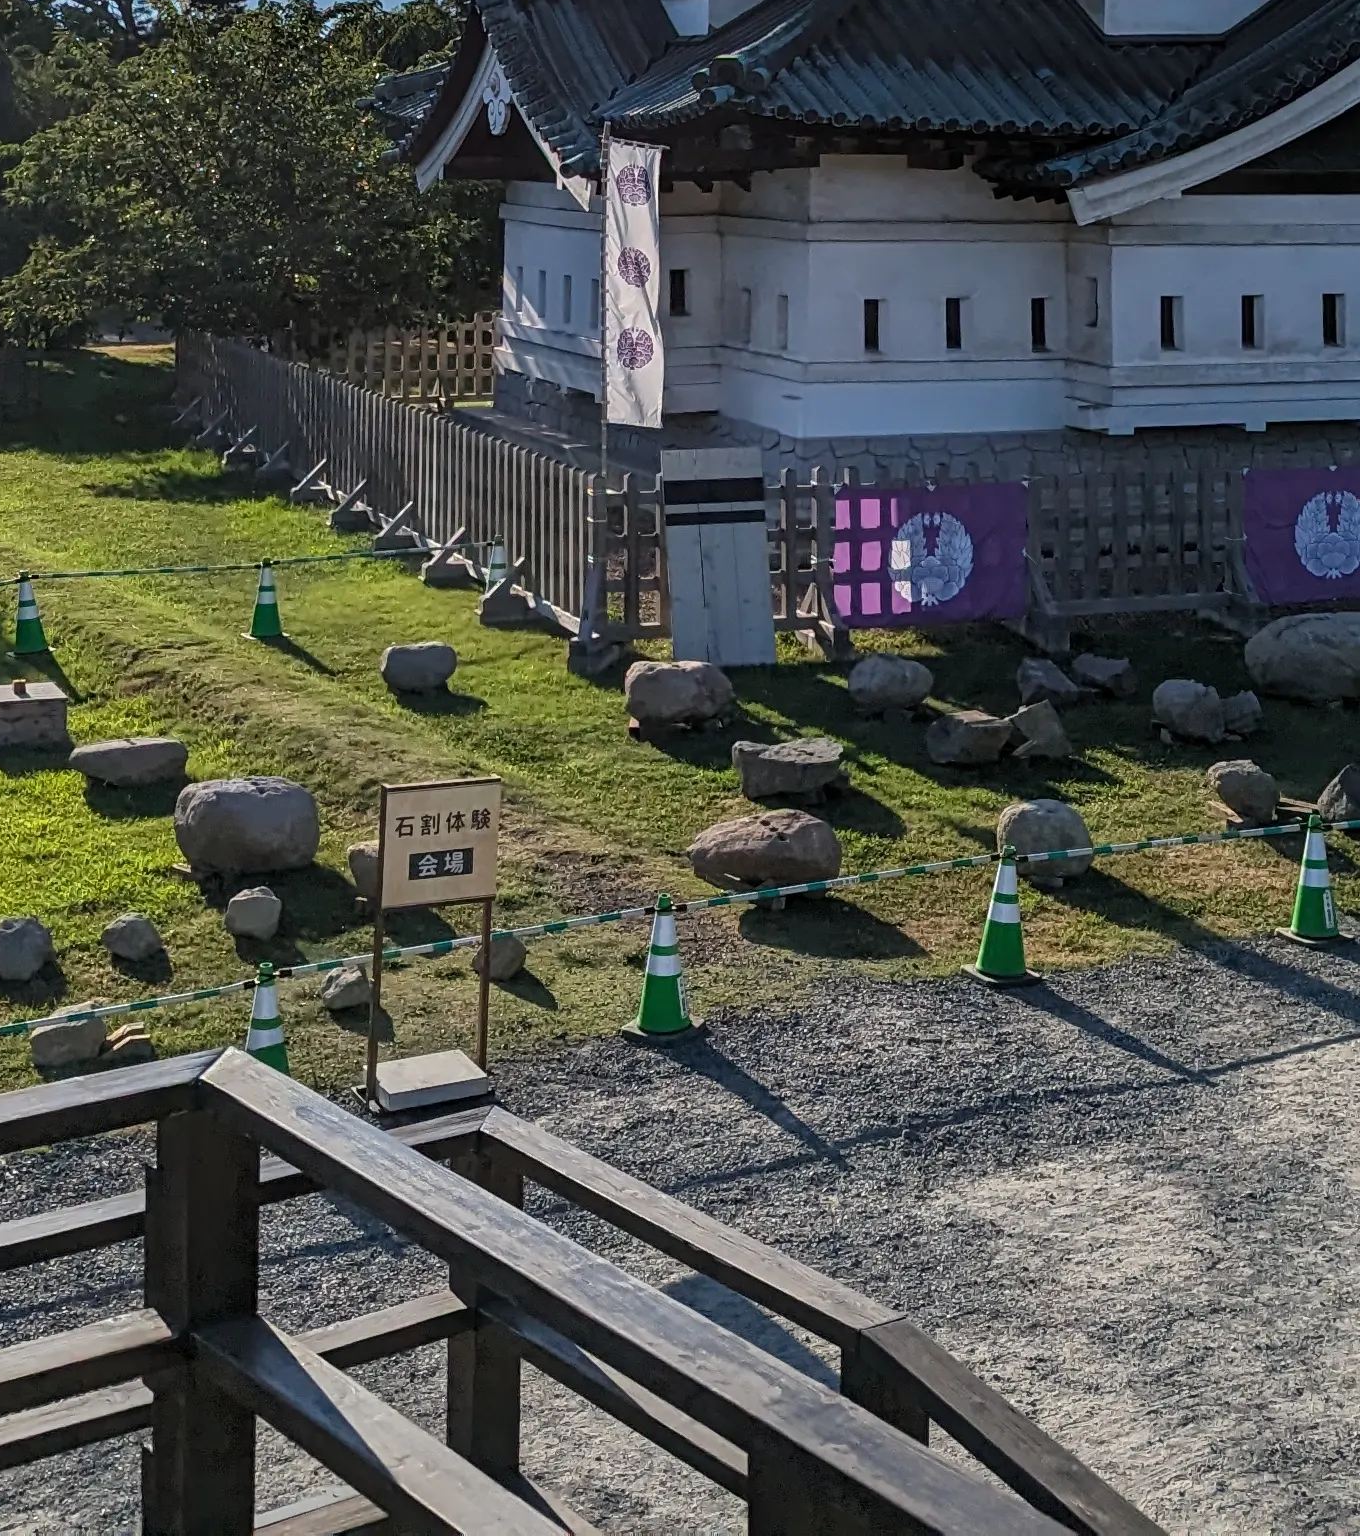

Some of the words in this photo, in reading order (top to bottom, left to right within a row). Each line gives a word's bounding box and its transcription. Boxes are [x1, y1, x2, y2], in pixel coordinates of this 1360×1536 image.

[395, 808, 491, 838] 石割体験
[418, 851, 464, 877] 会場
